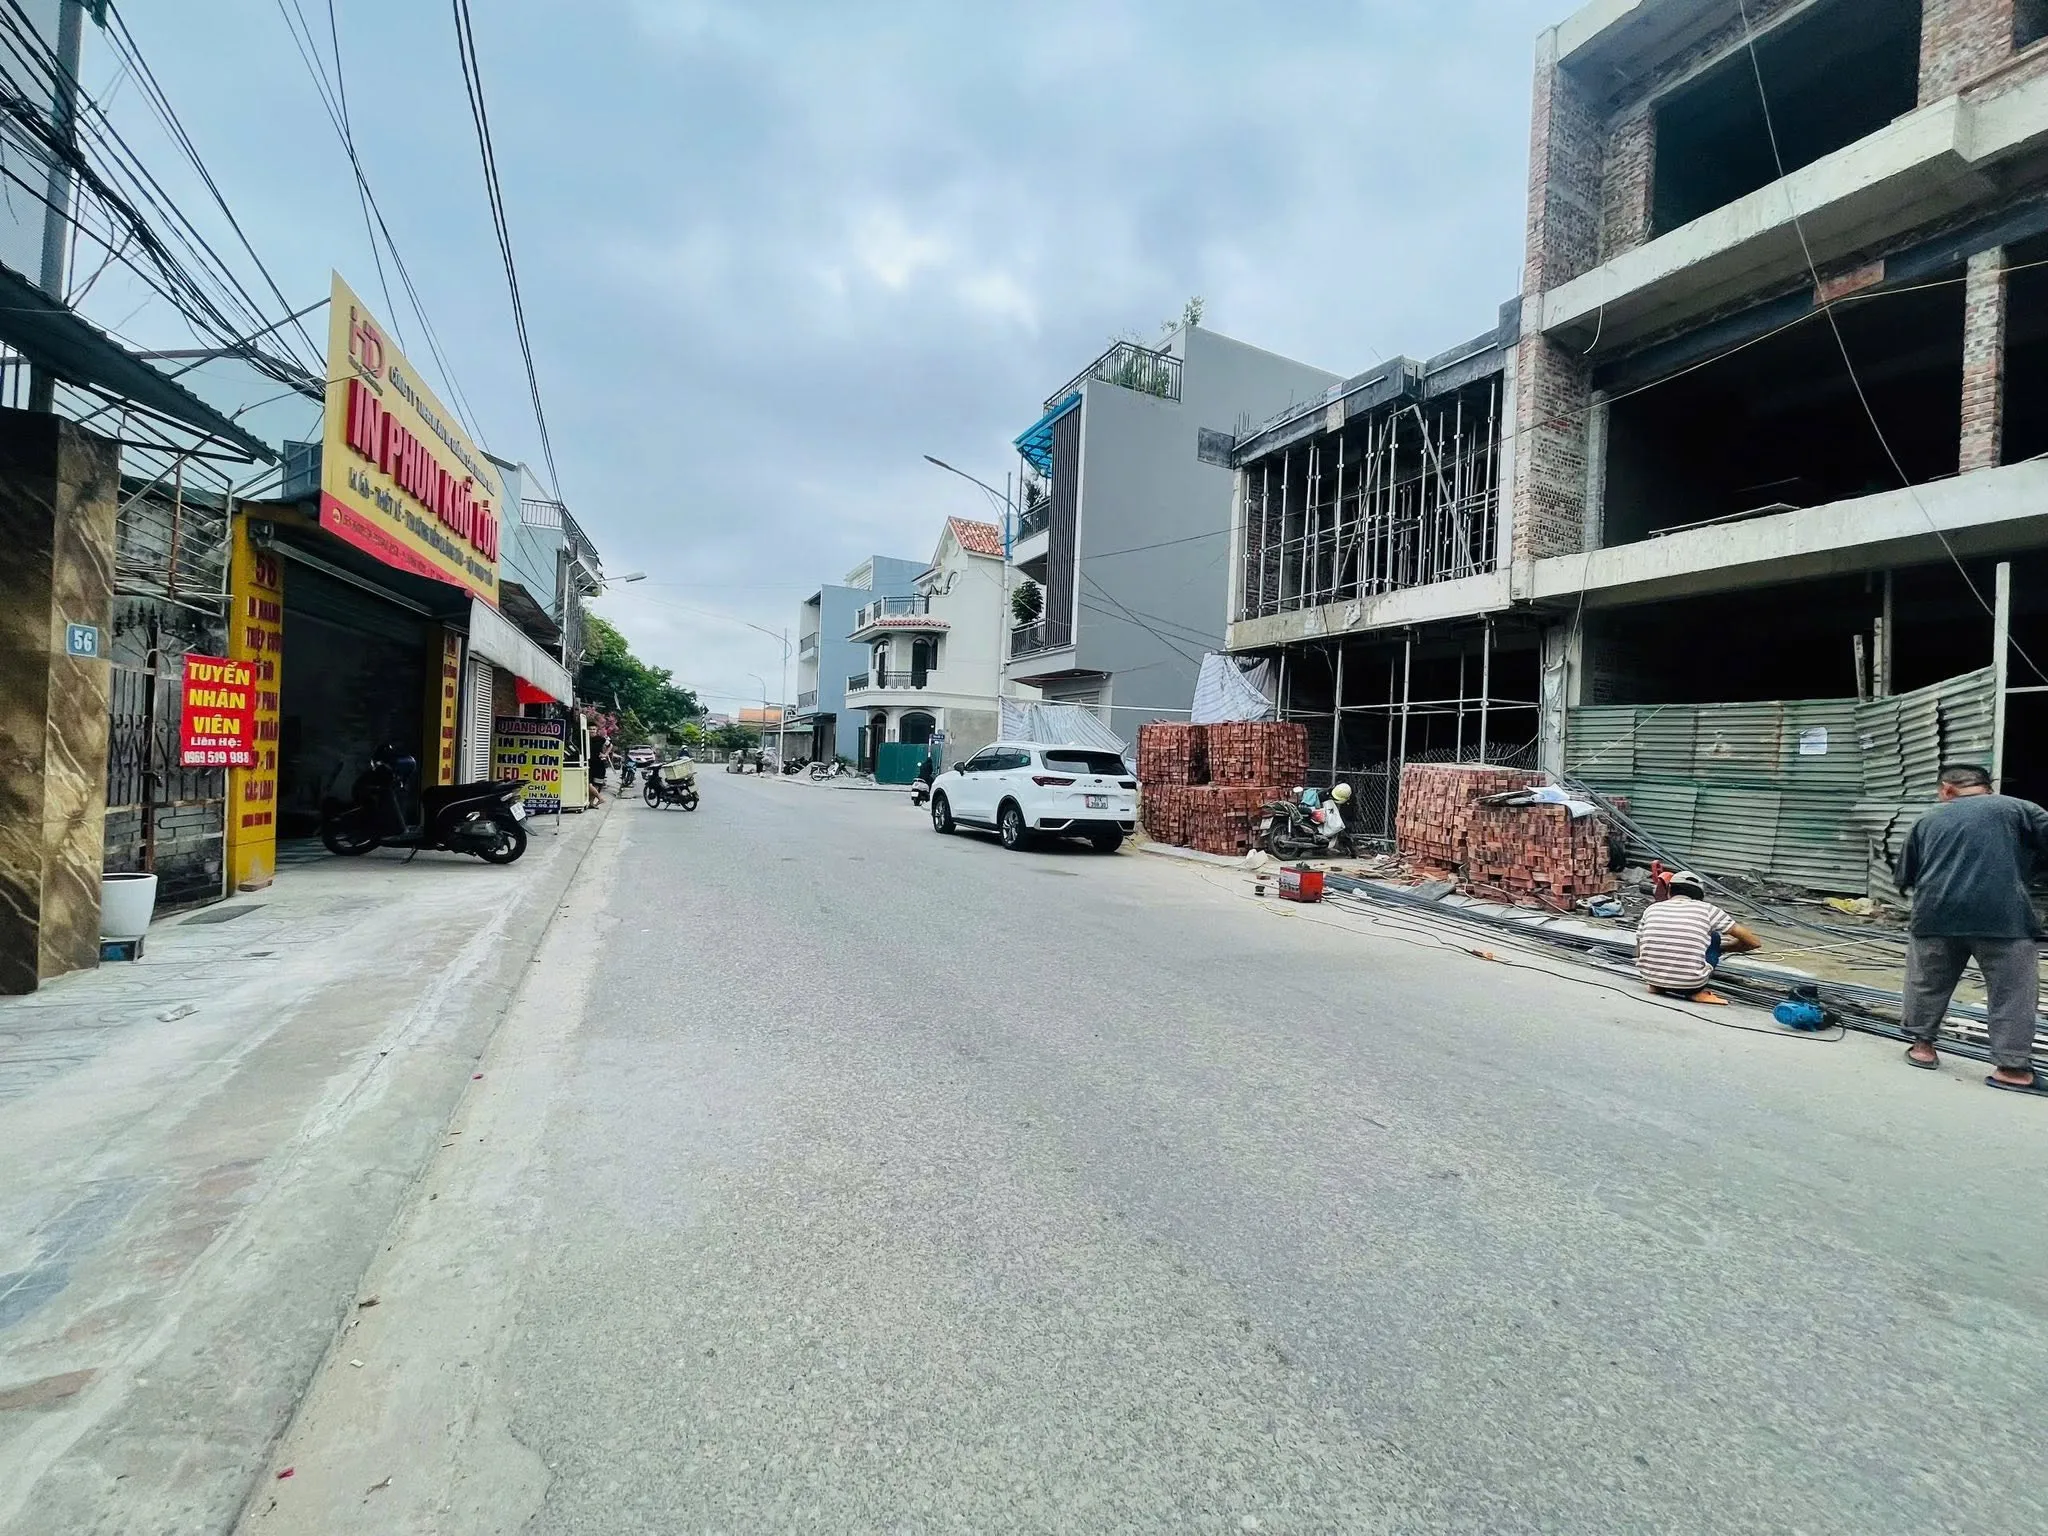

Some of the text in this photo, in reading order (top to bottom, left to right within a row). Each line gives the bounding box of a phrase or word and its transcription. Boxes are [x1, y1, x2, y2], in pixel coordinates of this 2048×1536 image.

[348, 379, 381, 464] IN
[381, 411, 440, 513] PHUN
[74, 629, 93, 652] 56
[188, 661, 250, 686] TUYỂN
[189, 688, 246, 710] NHÂN
[193, 714, 240, 735] VIÊN
[537, 721, 561, 735] CÁO
[498, 737, 559, 750] IN PHUN
[496, 767, 519, 780] LED
[533, 768, 559, 781] CNC
